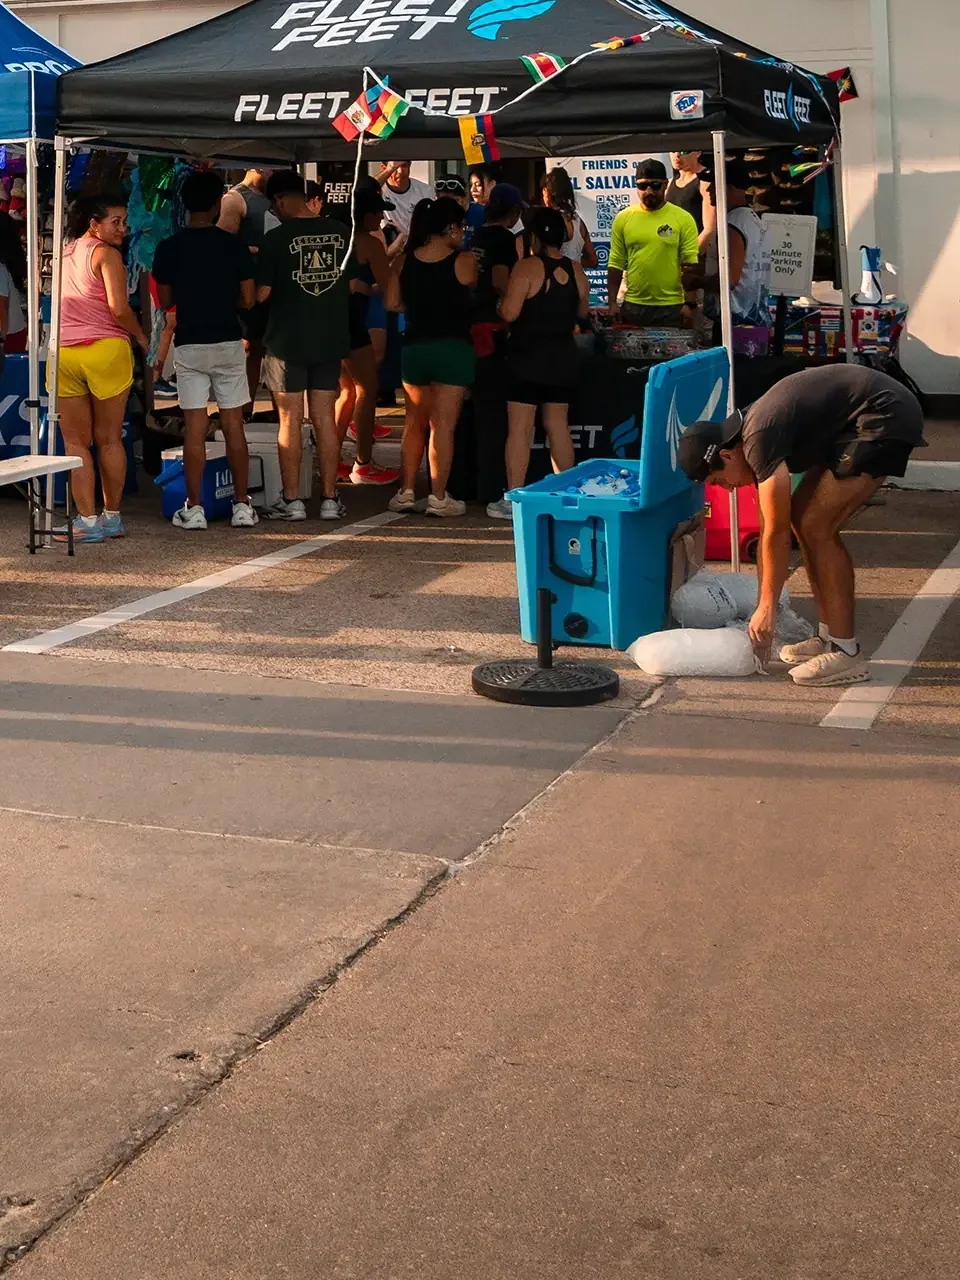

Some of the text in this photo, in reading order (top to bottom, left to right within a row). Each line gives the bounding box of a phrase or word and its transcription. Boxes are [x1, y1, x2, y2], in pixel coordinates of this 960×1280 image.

[271, 15, 457, 51] FEET
[234, 87, 499, 121] FLEET FEET
[764, 89, 811, 123] FLEET FEET
[582, 159, 628, 170] FRIENDS
[324, 182, 352, 193] FLEET
[586, 175, 637, 190] SALVA
[327, 192, 350, 203] FEET
[297, 236, 335, 244] ESCAPE
[781, 241, 792, 249] 30
[770, 249, 802, 258] Minute
[774, 266, 795, 276] Only
[530, 425, 603, 448] LET
